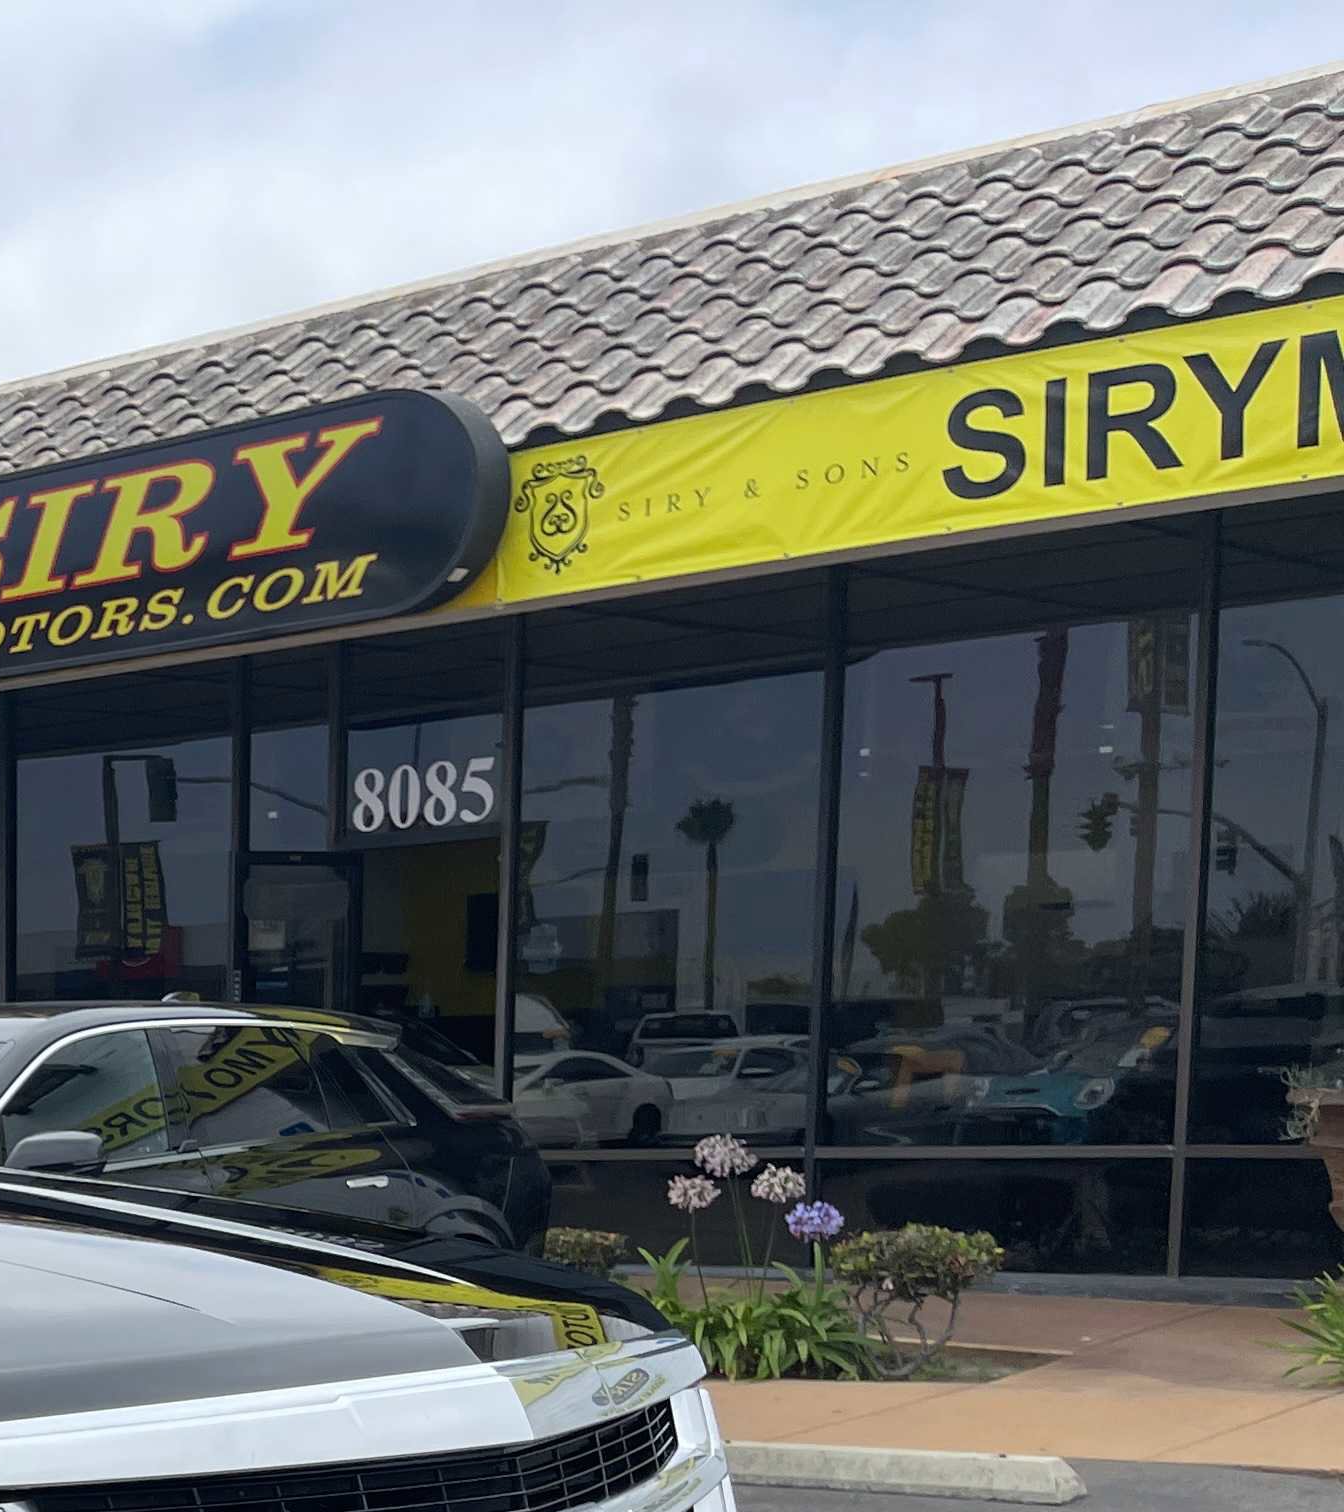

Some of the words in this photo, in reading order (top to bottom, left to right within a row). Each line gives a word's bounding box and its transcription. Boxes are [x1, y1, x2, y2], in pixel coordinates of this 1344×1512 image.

[618, 487, 711, 522] SIRY
[744, 478, 761, 499] &
[796, 452, 910, 490] SONS
[352, 757, 495, 832] 8085
